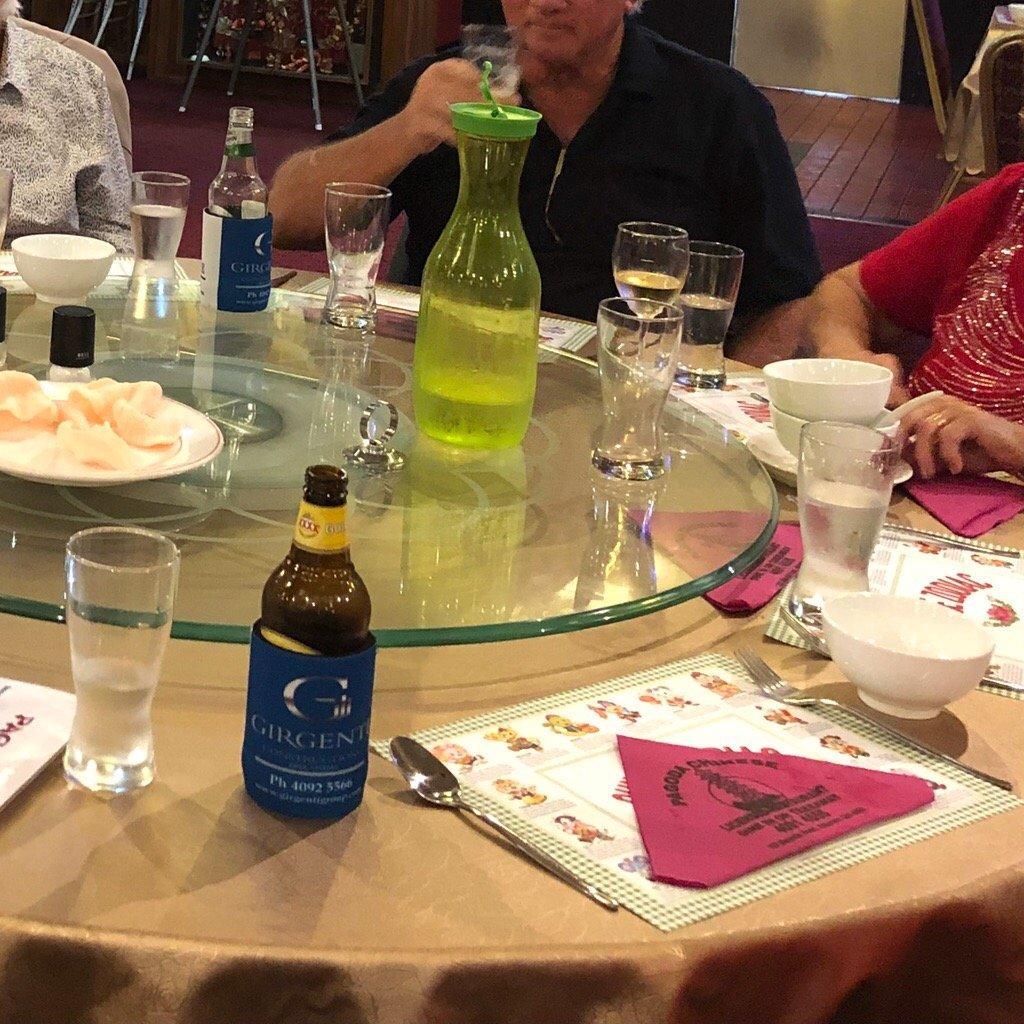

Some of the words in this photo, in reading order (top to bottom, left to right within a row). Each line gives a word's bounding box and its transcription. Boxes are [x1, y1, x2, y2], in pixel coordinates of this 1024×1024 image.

[269, 774, 287, 789] Ph
[663, 765, 690, 807] PAGODA
[687, 759, 778, 770] CHINESE
